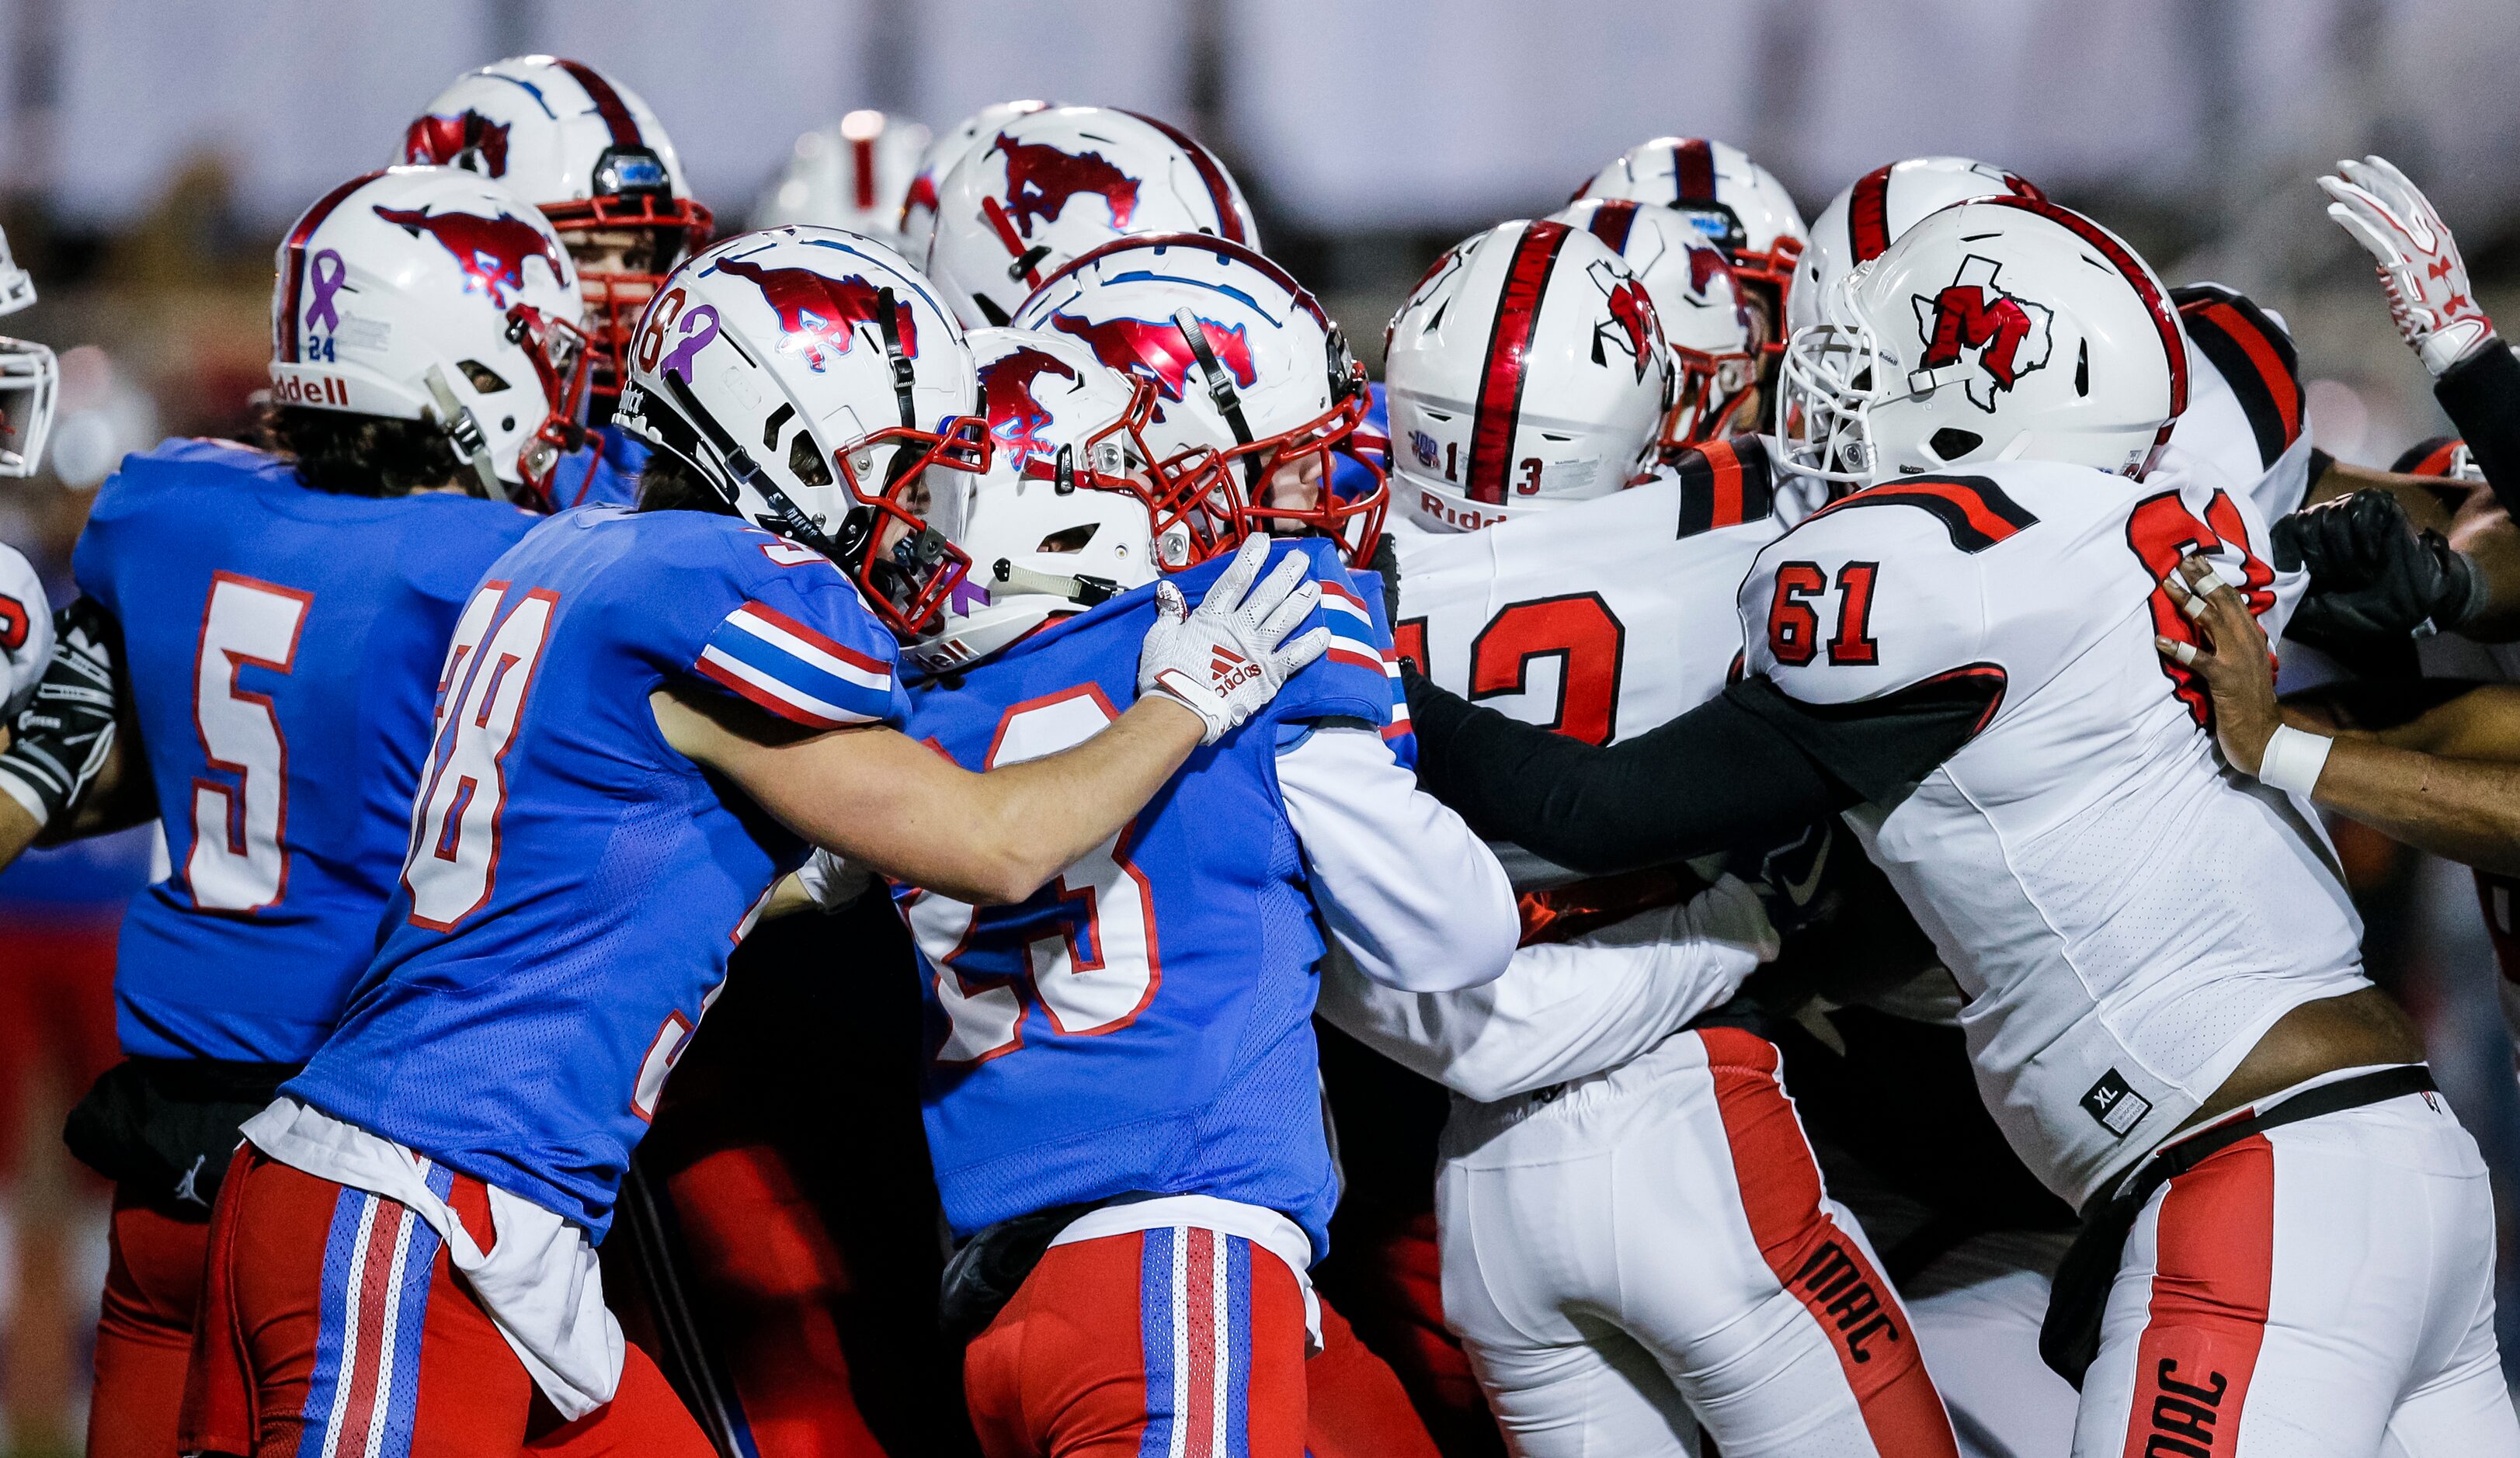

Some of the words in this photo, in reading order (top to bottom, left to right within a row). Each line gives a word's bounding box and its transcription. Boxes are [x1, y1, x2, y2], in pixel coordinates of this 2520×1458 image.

[309, 335, 335, 363] 24
[638, 287, 686, 374] 8
[1920, 284, 2032, 393] M
[1767, 560, 1880, 668] 61
[1215, 663, 1263, 699] adidas
[183, 569, 315, 915] 5
[2093, 1086, 2119, 1109] XL
[1792, 1240, 1900, 1364] MAC
